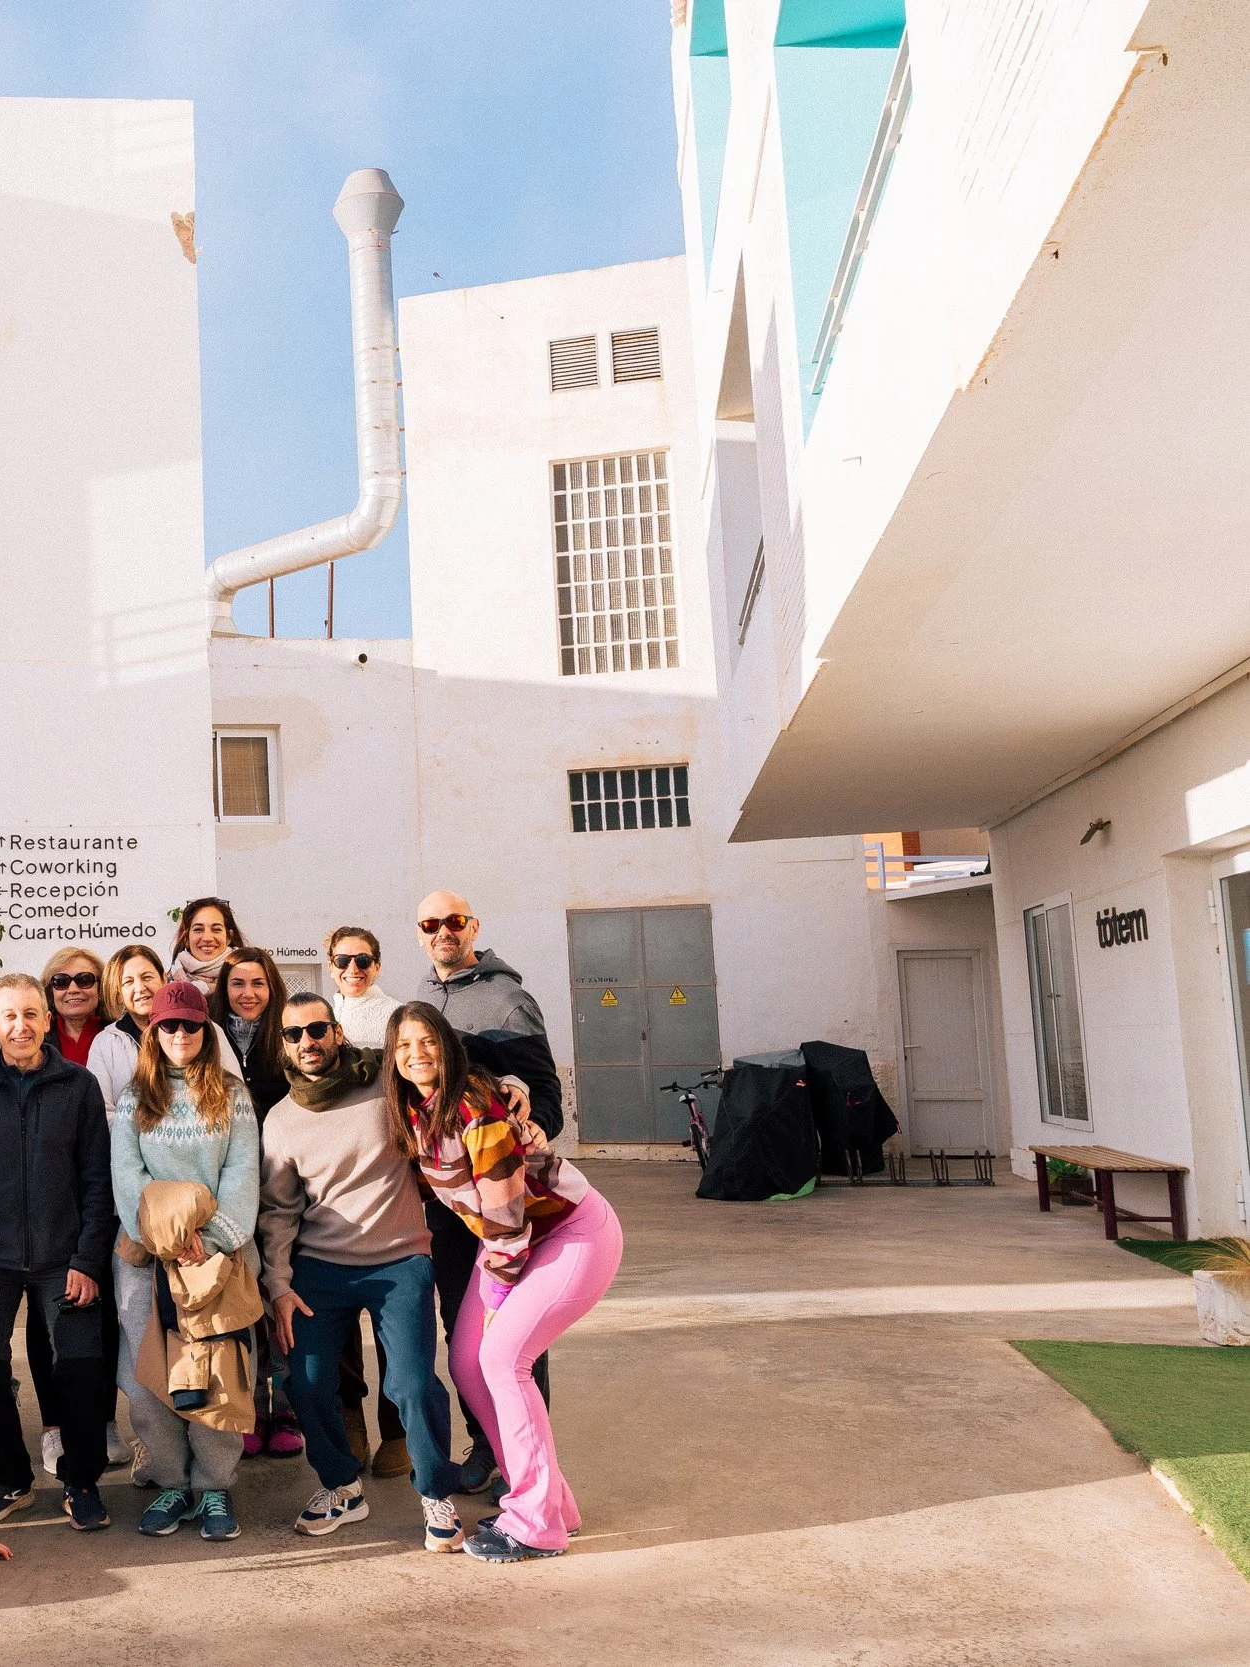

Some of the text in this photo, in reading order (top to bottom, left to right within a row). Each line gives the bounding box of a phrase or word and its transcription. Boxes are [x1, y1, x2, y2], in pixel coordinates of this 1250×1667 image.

[10, 835, 138, 850] Restaurante
[10, 858, 117, 878] Coworking
[10, 881, 119, 901] Recepción
[9, 902, 99, 919] Comedor
[9, 922, 157, 940] Cuarto Húmedo
[276, 947, 318, 957] Húmedo
